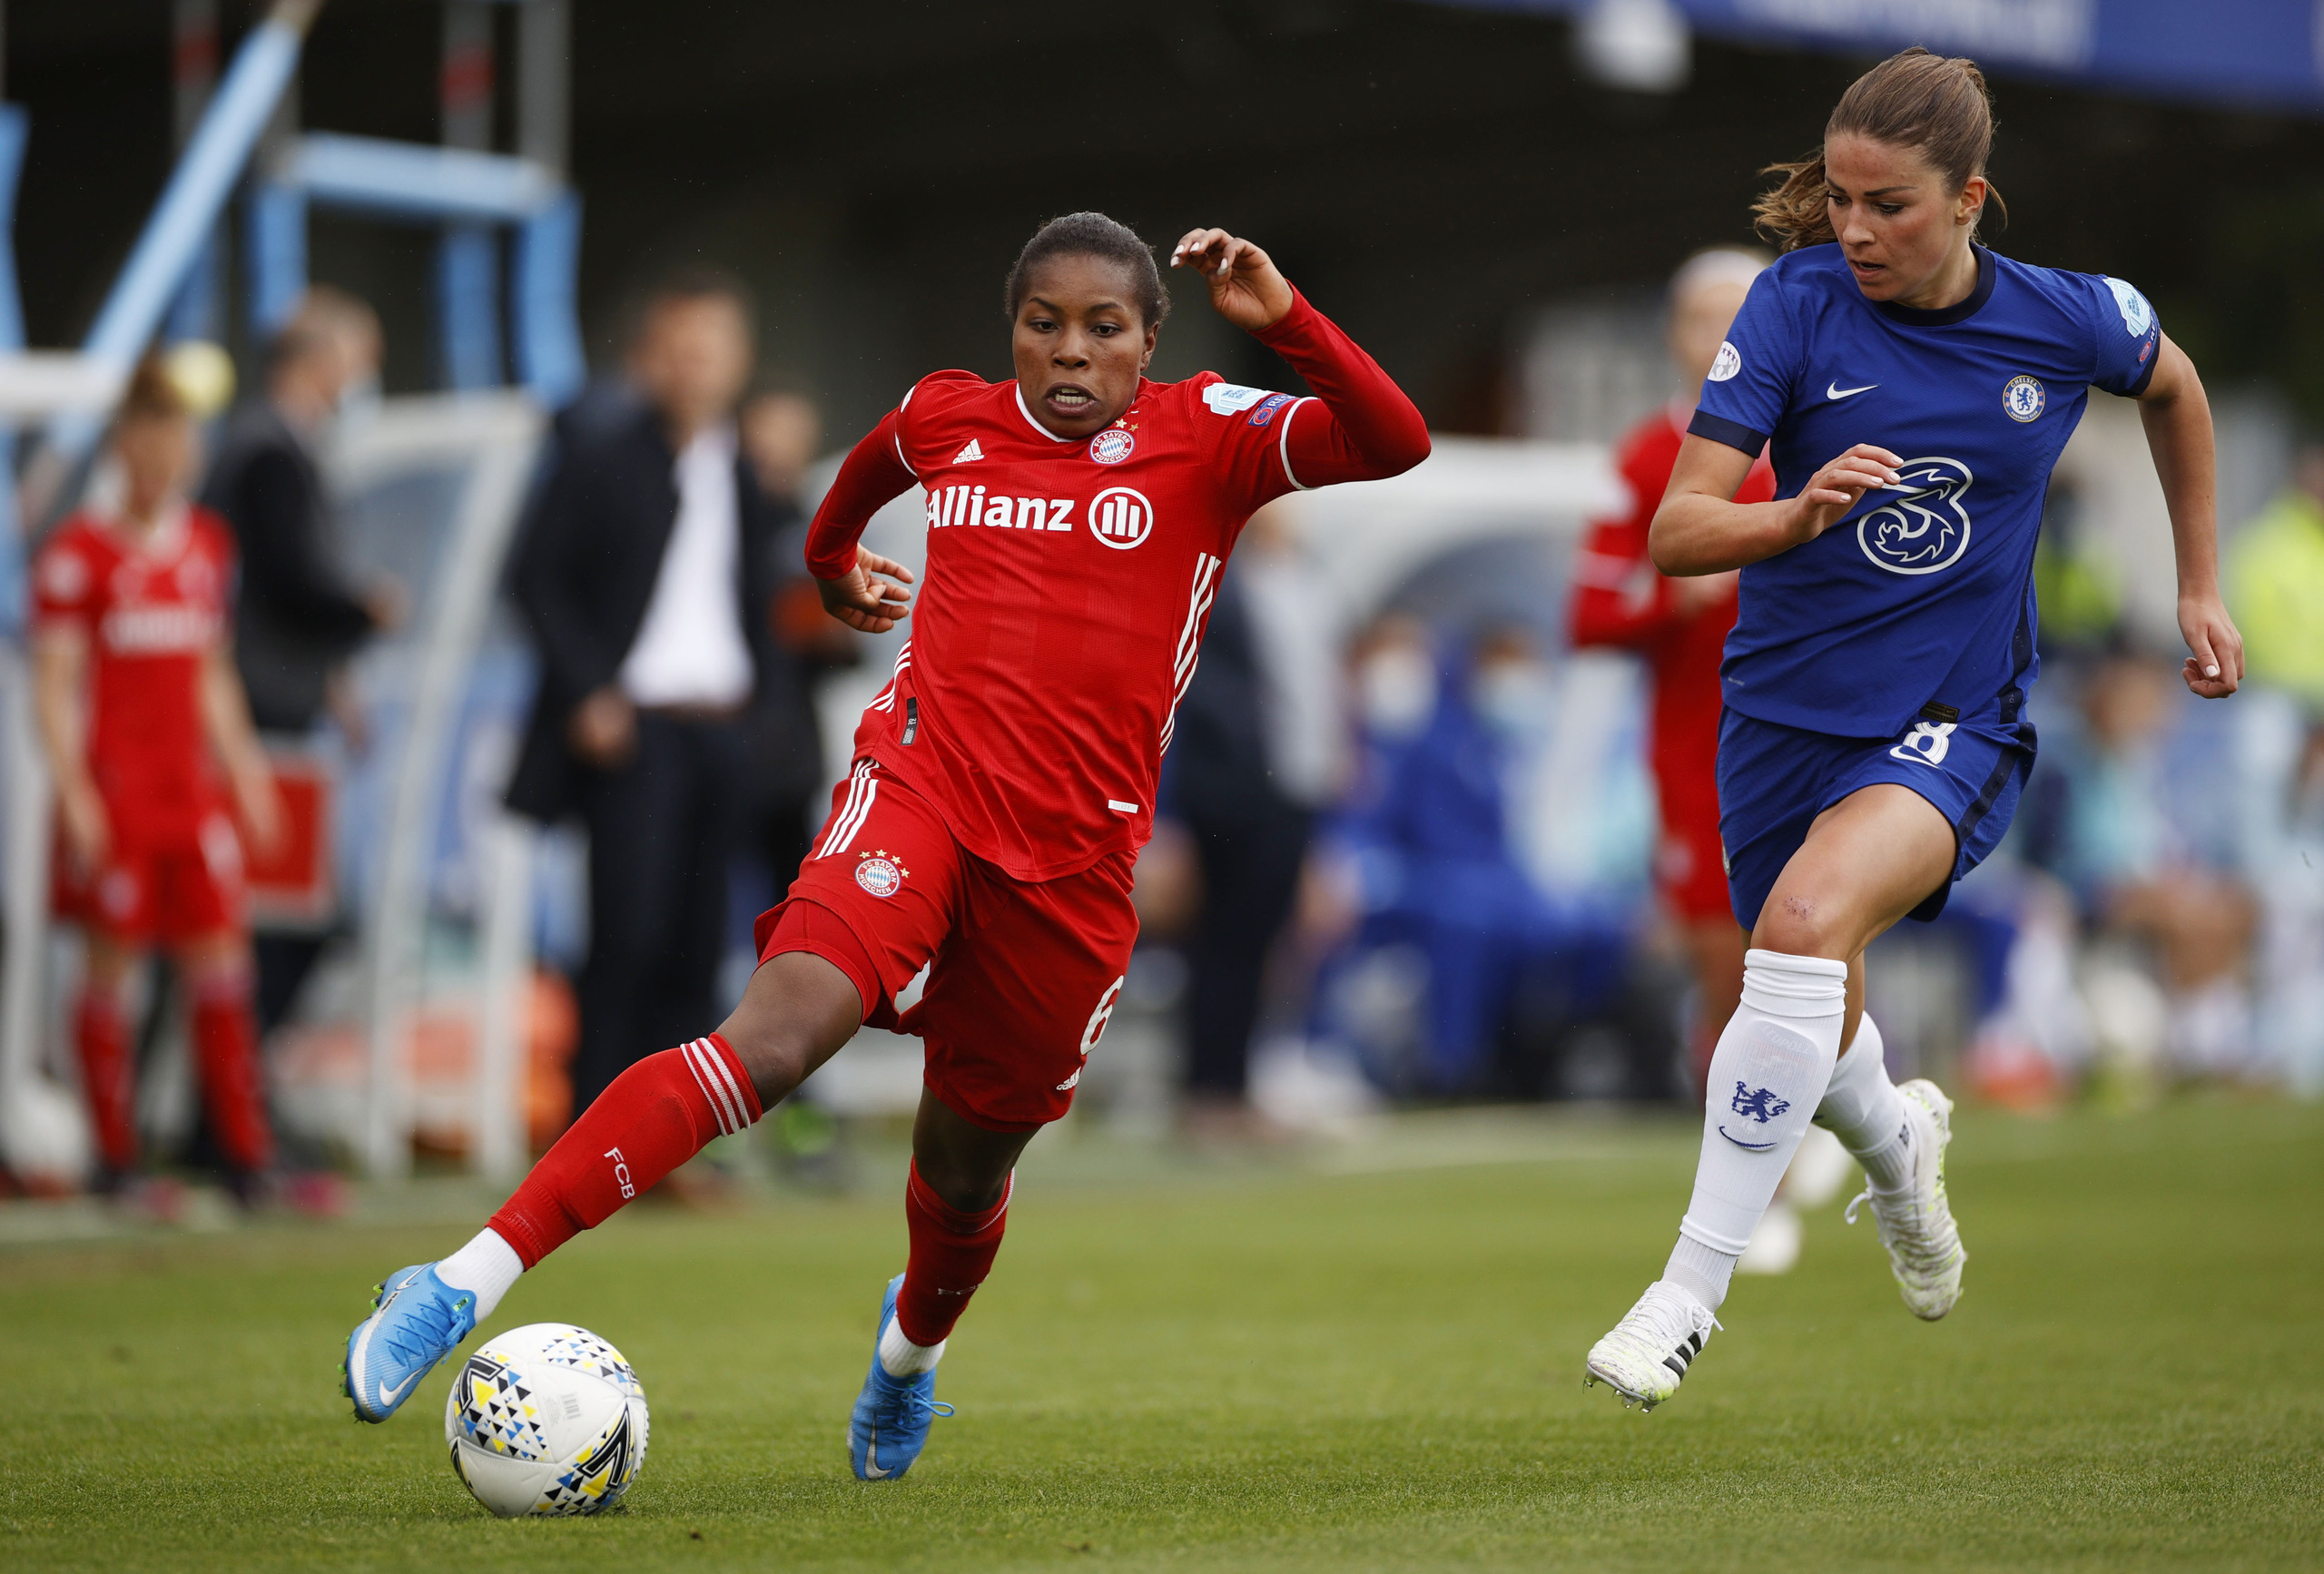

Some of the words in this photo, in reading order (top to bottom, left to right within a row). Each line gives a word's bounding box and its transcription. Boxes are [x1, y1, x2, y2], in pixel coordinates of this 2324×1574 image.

[2010, 378, 2037, 388] CHELSEA
[1094, 438, 1103, 447] FC
[1103, 432, 1131, 444] BAYERN
[952, 454, 985, 465] adidas
[926, 485, 1075, 532] Allianz
[1902, 721, 1958, 765] 8
[874, 861, 897, 883] BAYERN
[1080, 975, 1124, 1056] 6
[603, 1146, 635, 1200] FCB
